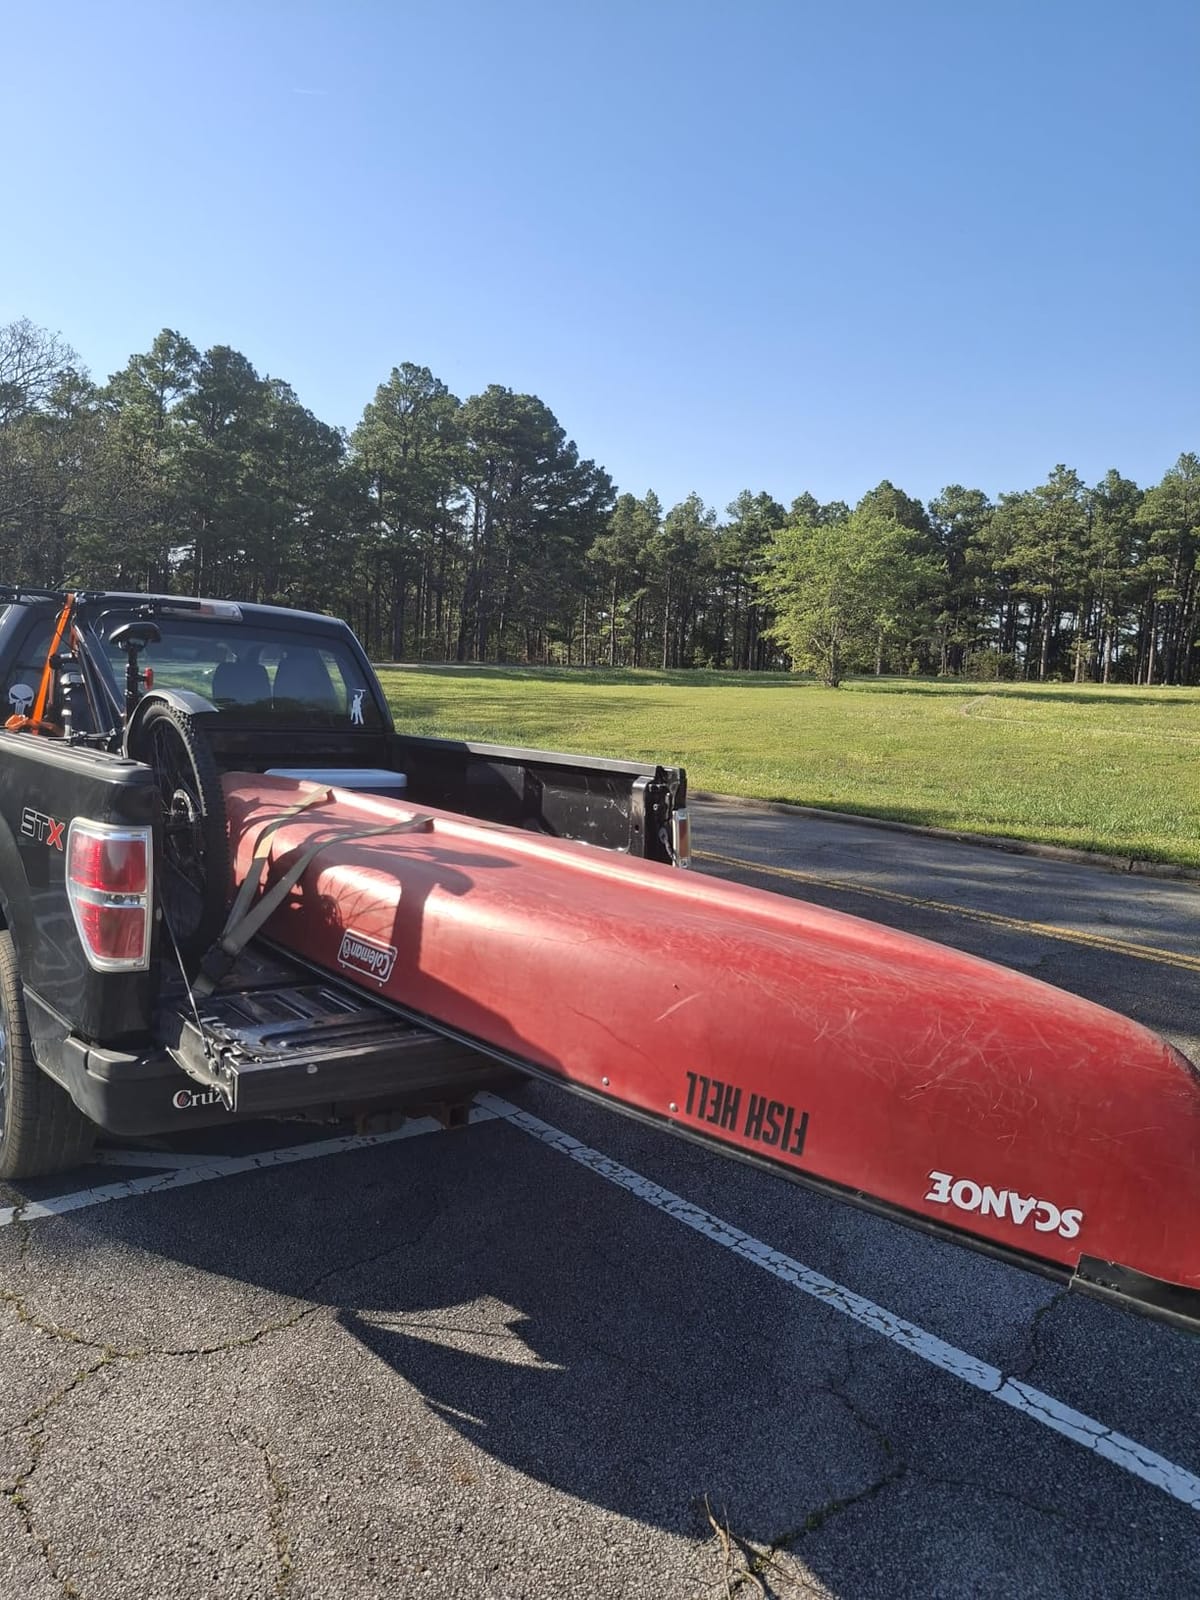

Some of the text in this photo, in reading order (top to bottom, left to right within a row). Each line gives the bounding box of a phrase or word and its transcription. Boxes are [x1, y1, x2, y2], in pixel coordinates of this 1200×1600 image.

[20, 806, 65, 851] STX
[350, 941, 390, 976] Coleman
[686, 1071, 809, 1156] FISH HELL
[925, 1170, 1083, 1238] SCANOE
